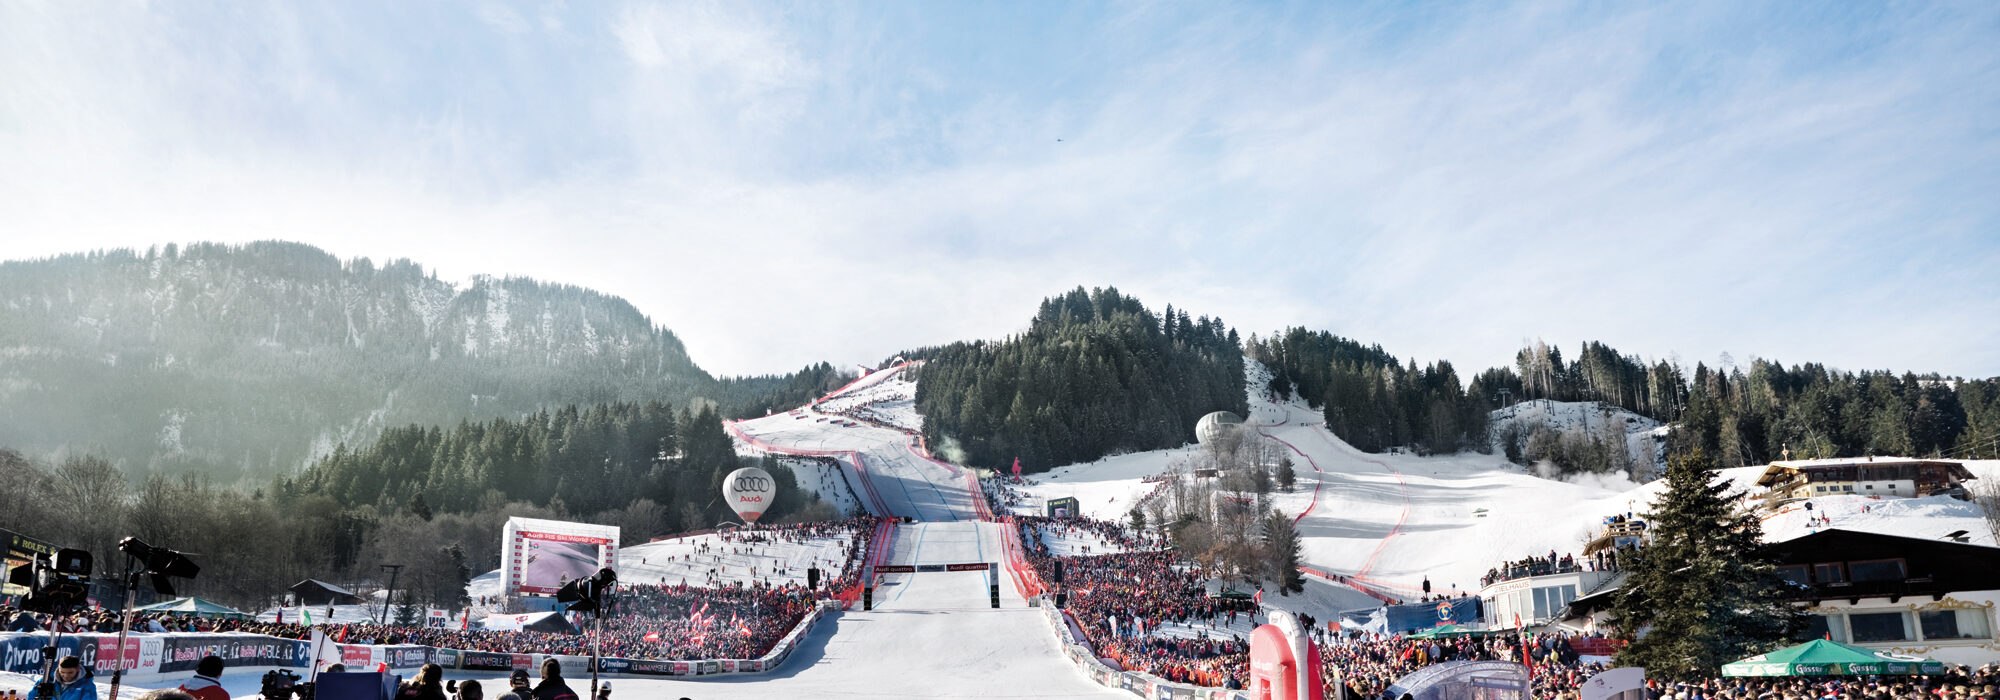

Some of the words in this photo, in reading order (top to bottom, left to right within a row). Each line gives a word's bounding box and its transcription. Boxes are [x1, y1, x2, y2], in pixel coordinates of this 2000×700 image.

[740, 495, 763, 503] Audi
[22, 540, 47, 554] ROLEX
[428, 617, 446, 628] WC
